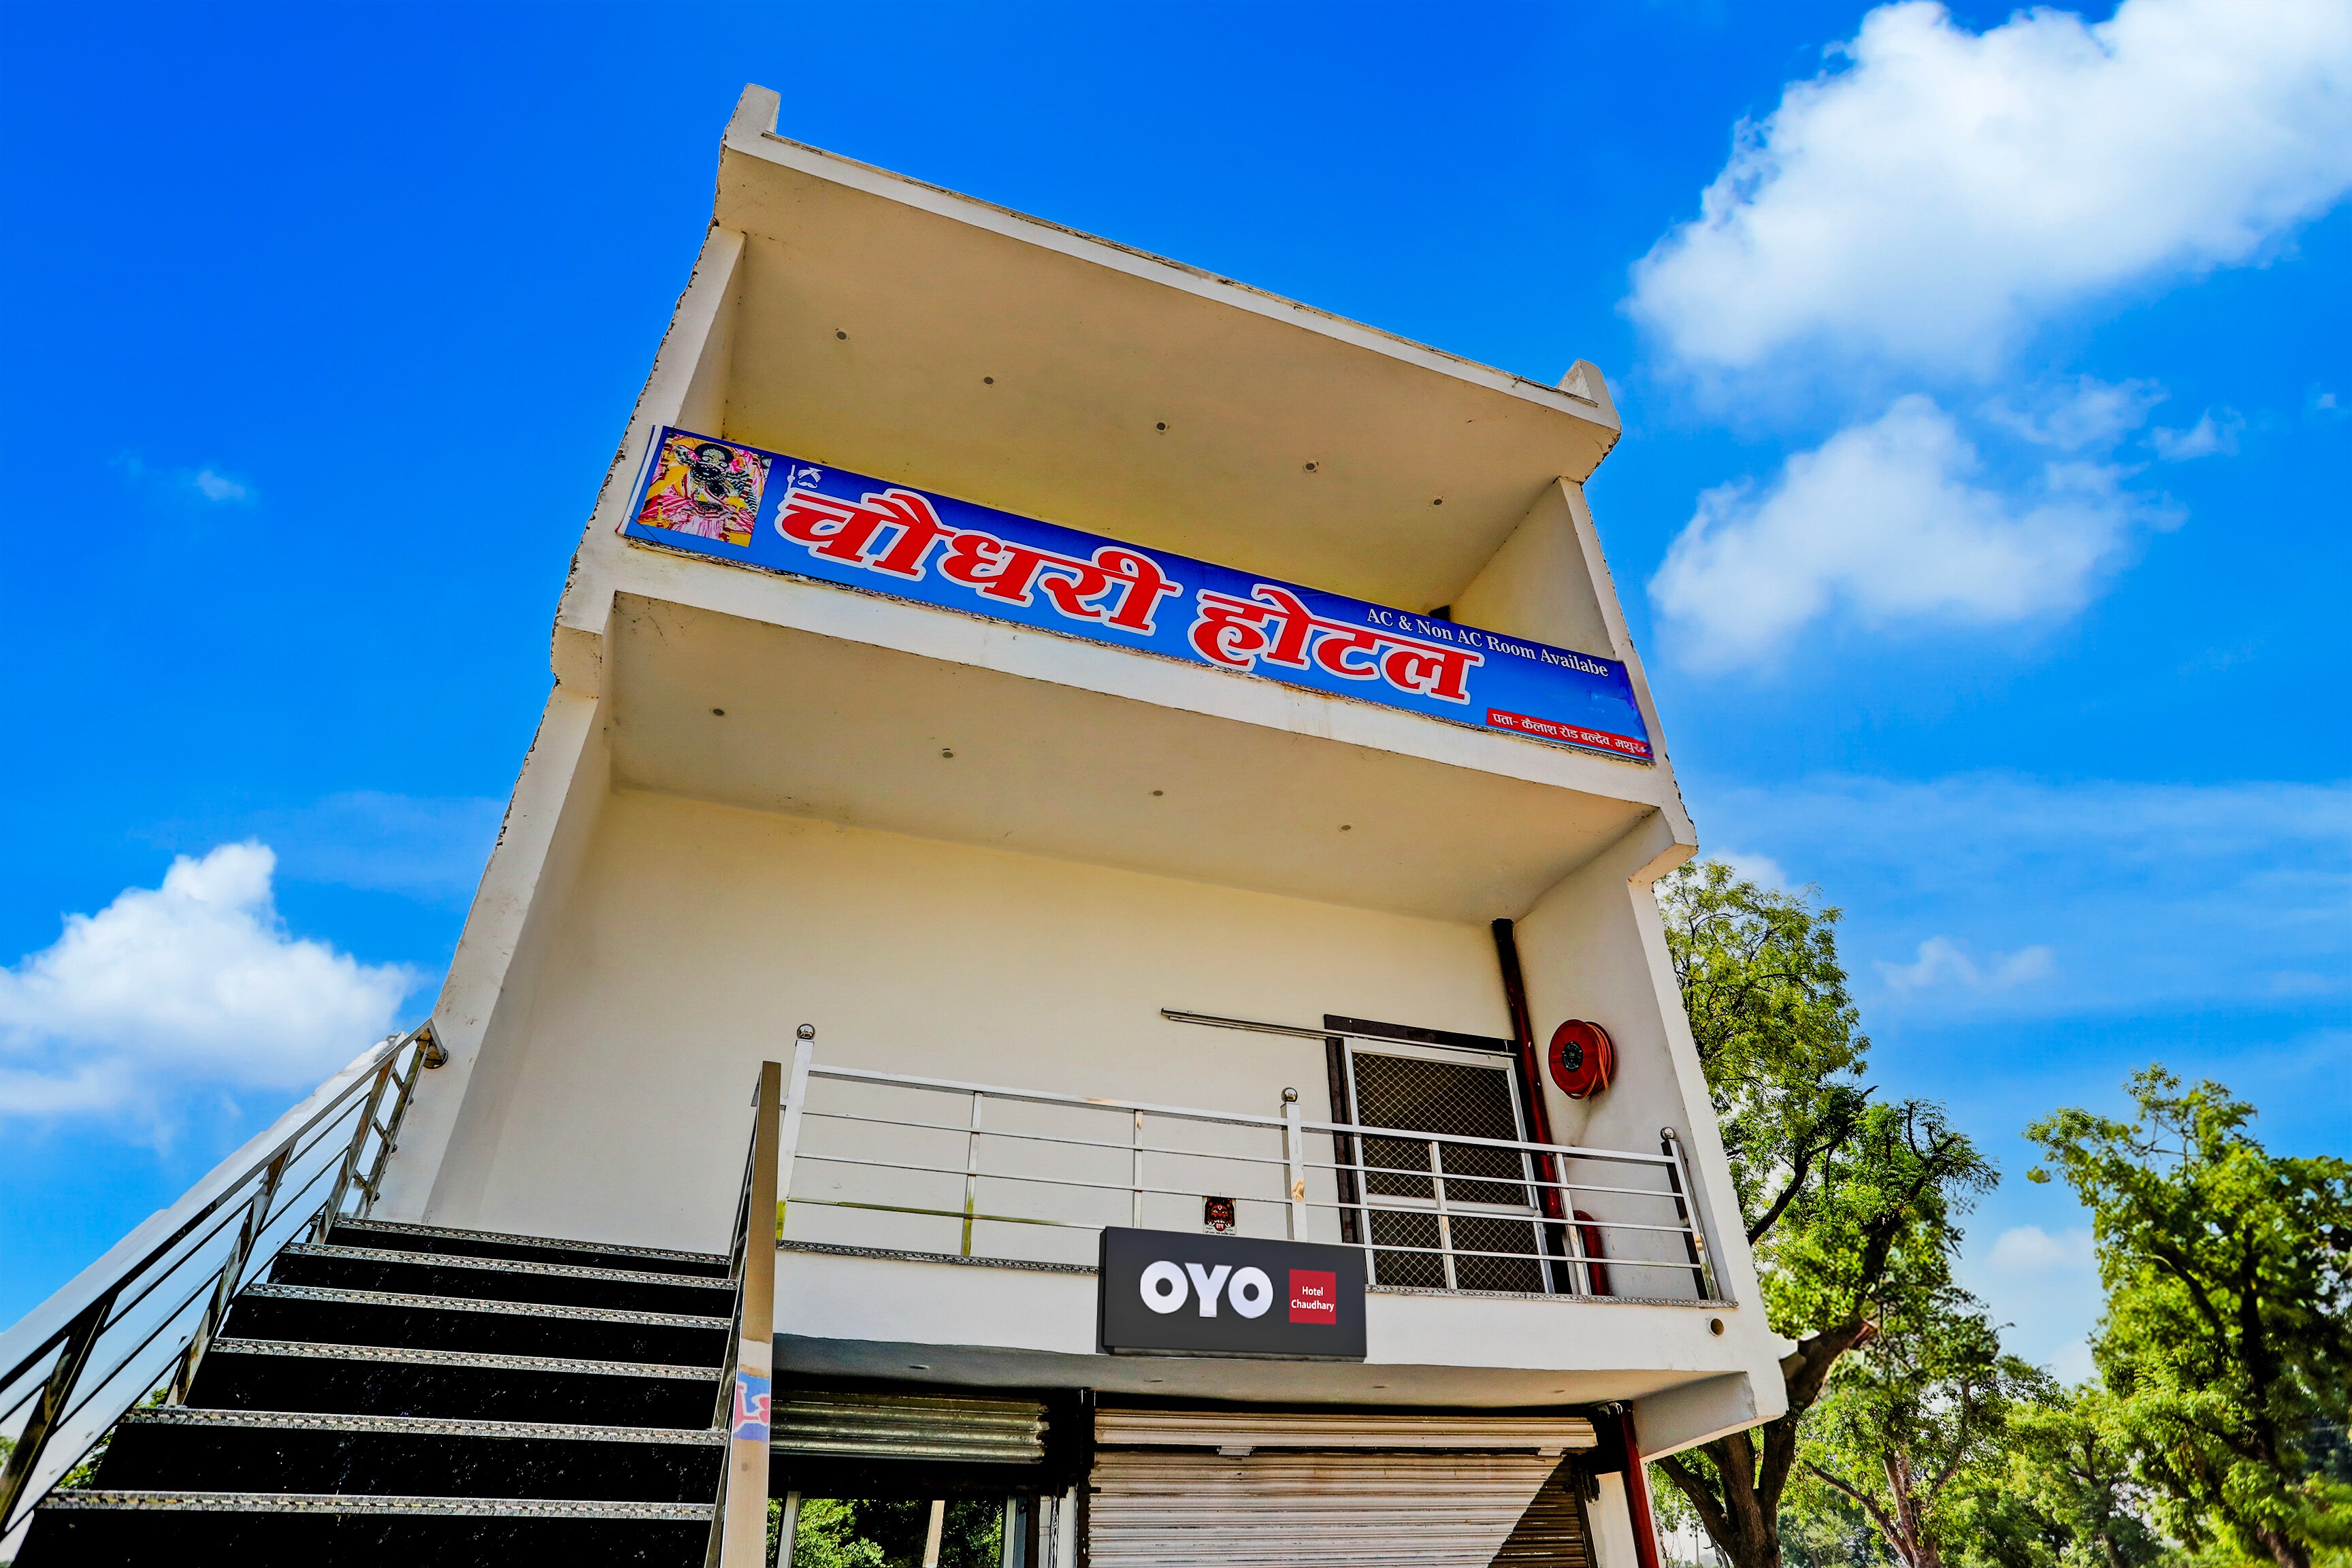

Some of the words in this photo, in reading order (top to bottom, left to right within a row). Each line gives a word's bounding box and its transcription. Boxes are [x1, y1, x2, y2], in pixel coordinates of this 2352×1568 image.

[777, 489, 1181, 634] चौधरी
[1190, 585, 1482, 704] होटल
[1367, 608, 1393, 627] AC
[1399, 615, 1413, 631] &
[1416, 619, 1454, 641] Non
[1457, 629, 1483, 647] AC
[1486, 635, 1537, 660] Room
[1540, 649, 1609, 677] Availabe
[1492, 713, 1518, 725] पता-
[1521, 717, 1557, 735] कैलाश
[1558, 725, 1579, 738] रोड
[1140, 1260, 1274, 1319] OYO
[1291, 1298, 1335, 1313] Chaudhary
[1302, 1286, 1324, 1296] Hotel
